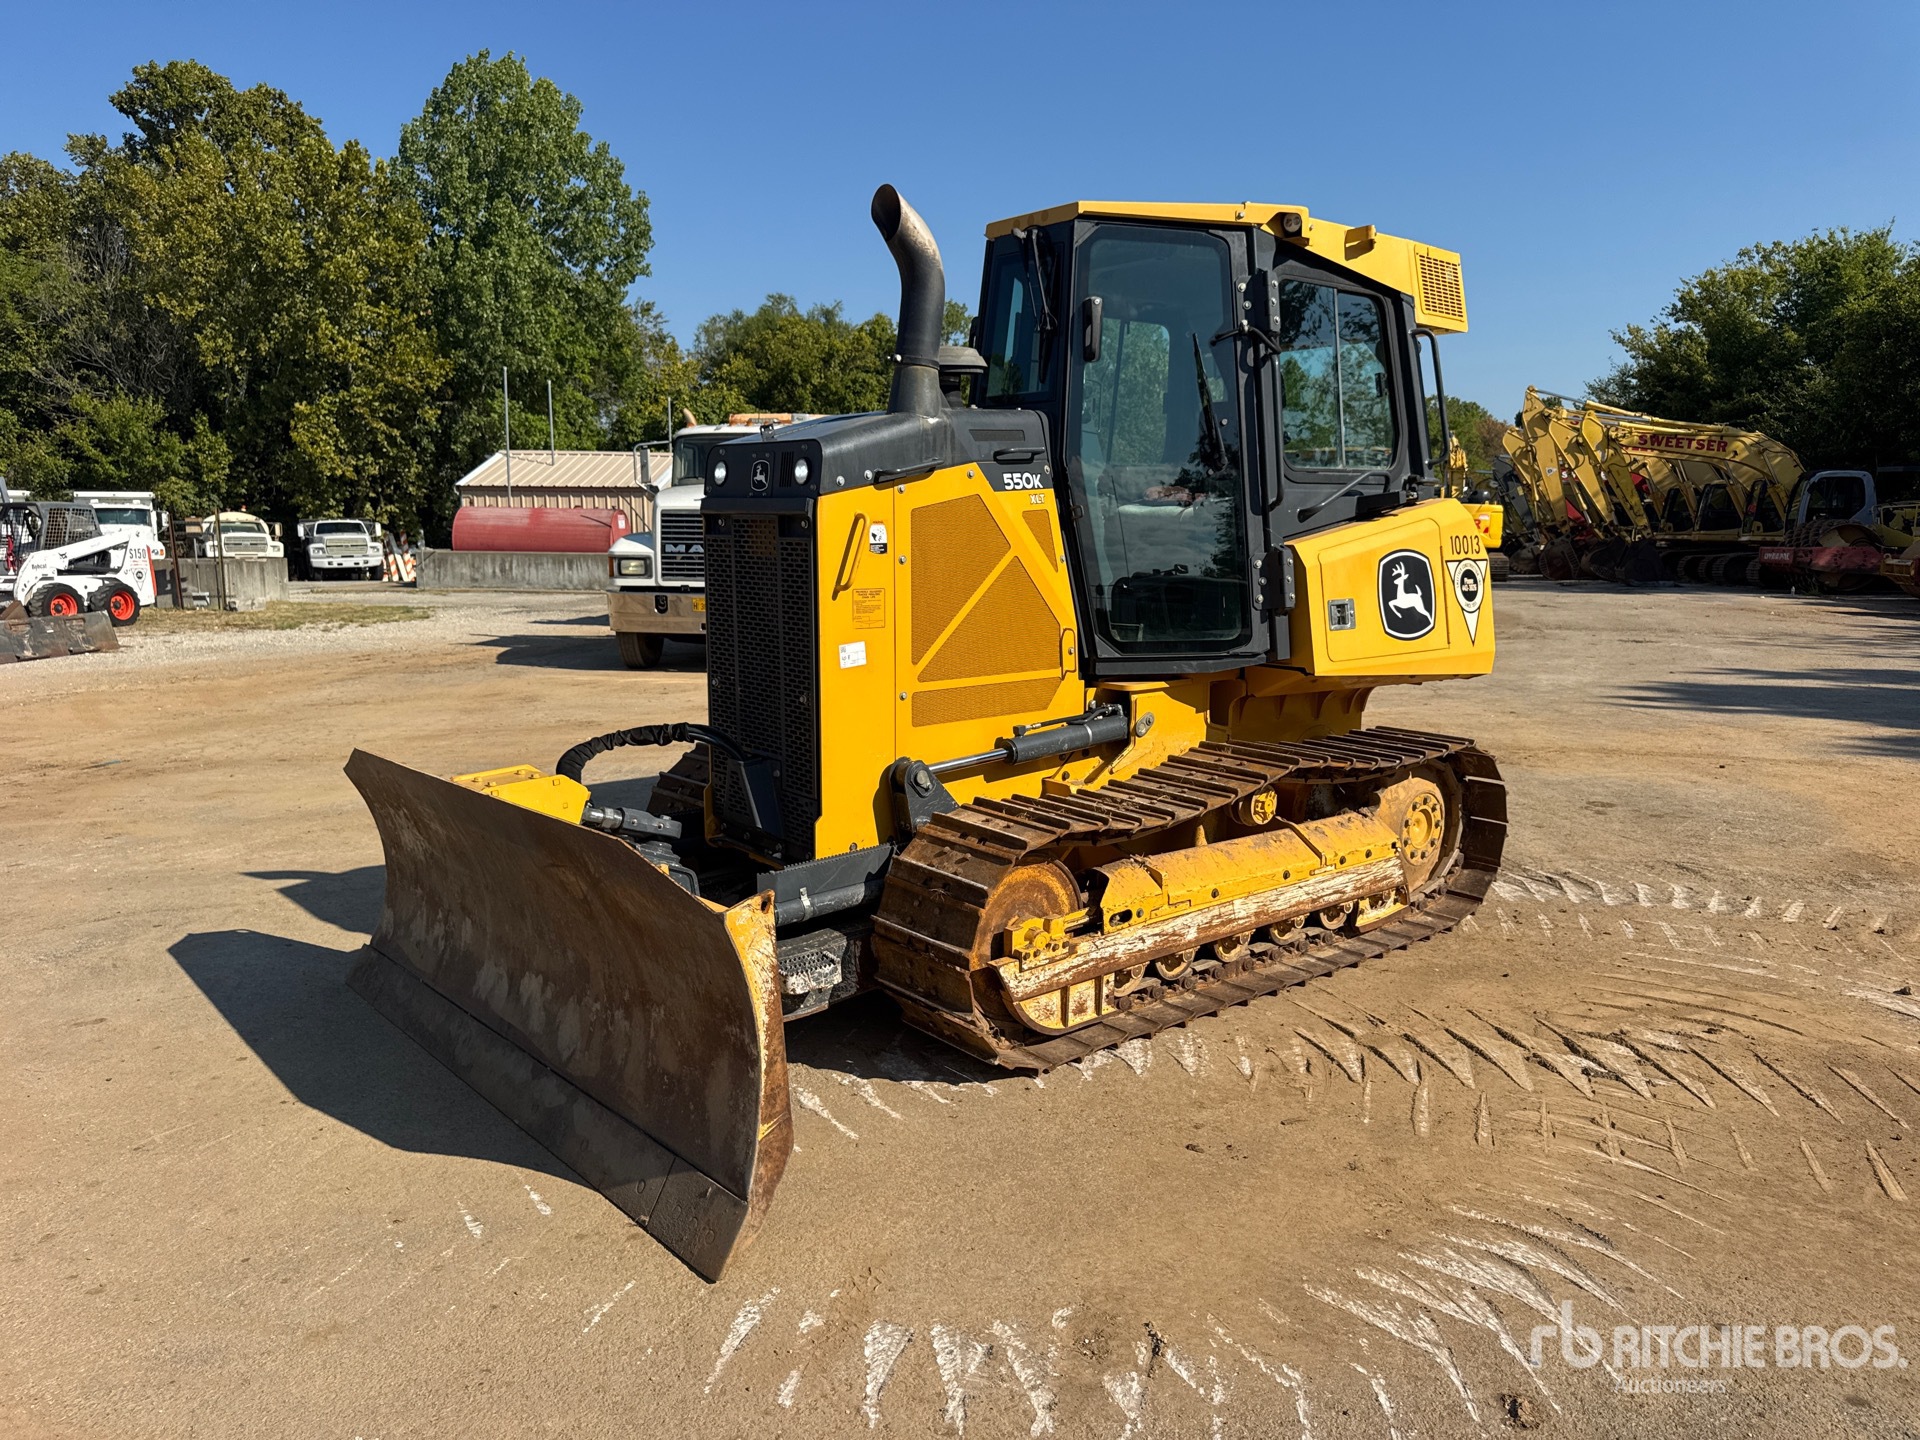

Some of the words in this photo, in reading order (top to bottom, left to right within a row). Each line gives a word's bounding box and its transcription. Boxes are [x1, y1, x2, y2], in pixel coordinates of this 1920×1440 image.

[1638, 433, 1728, 453] SWEETSER
[1003, 472, 1043, 490] 550K
[1029, 494, 1045, 504] XLT
[665, 544, 704, 553] MA
[1450, 535, 1480, 555] 10013
[129, 548, 146, 559] S150
